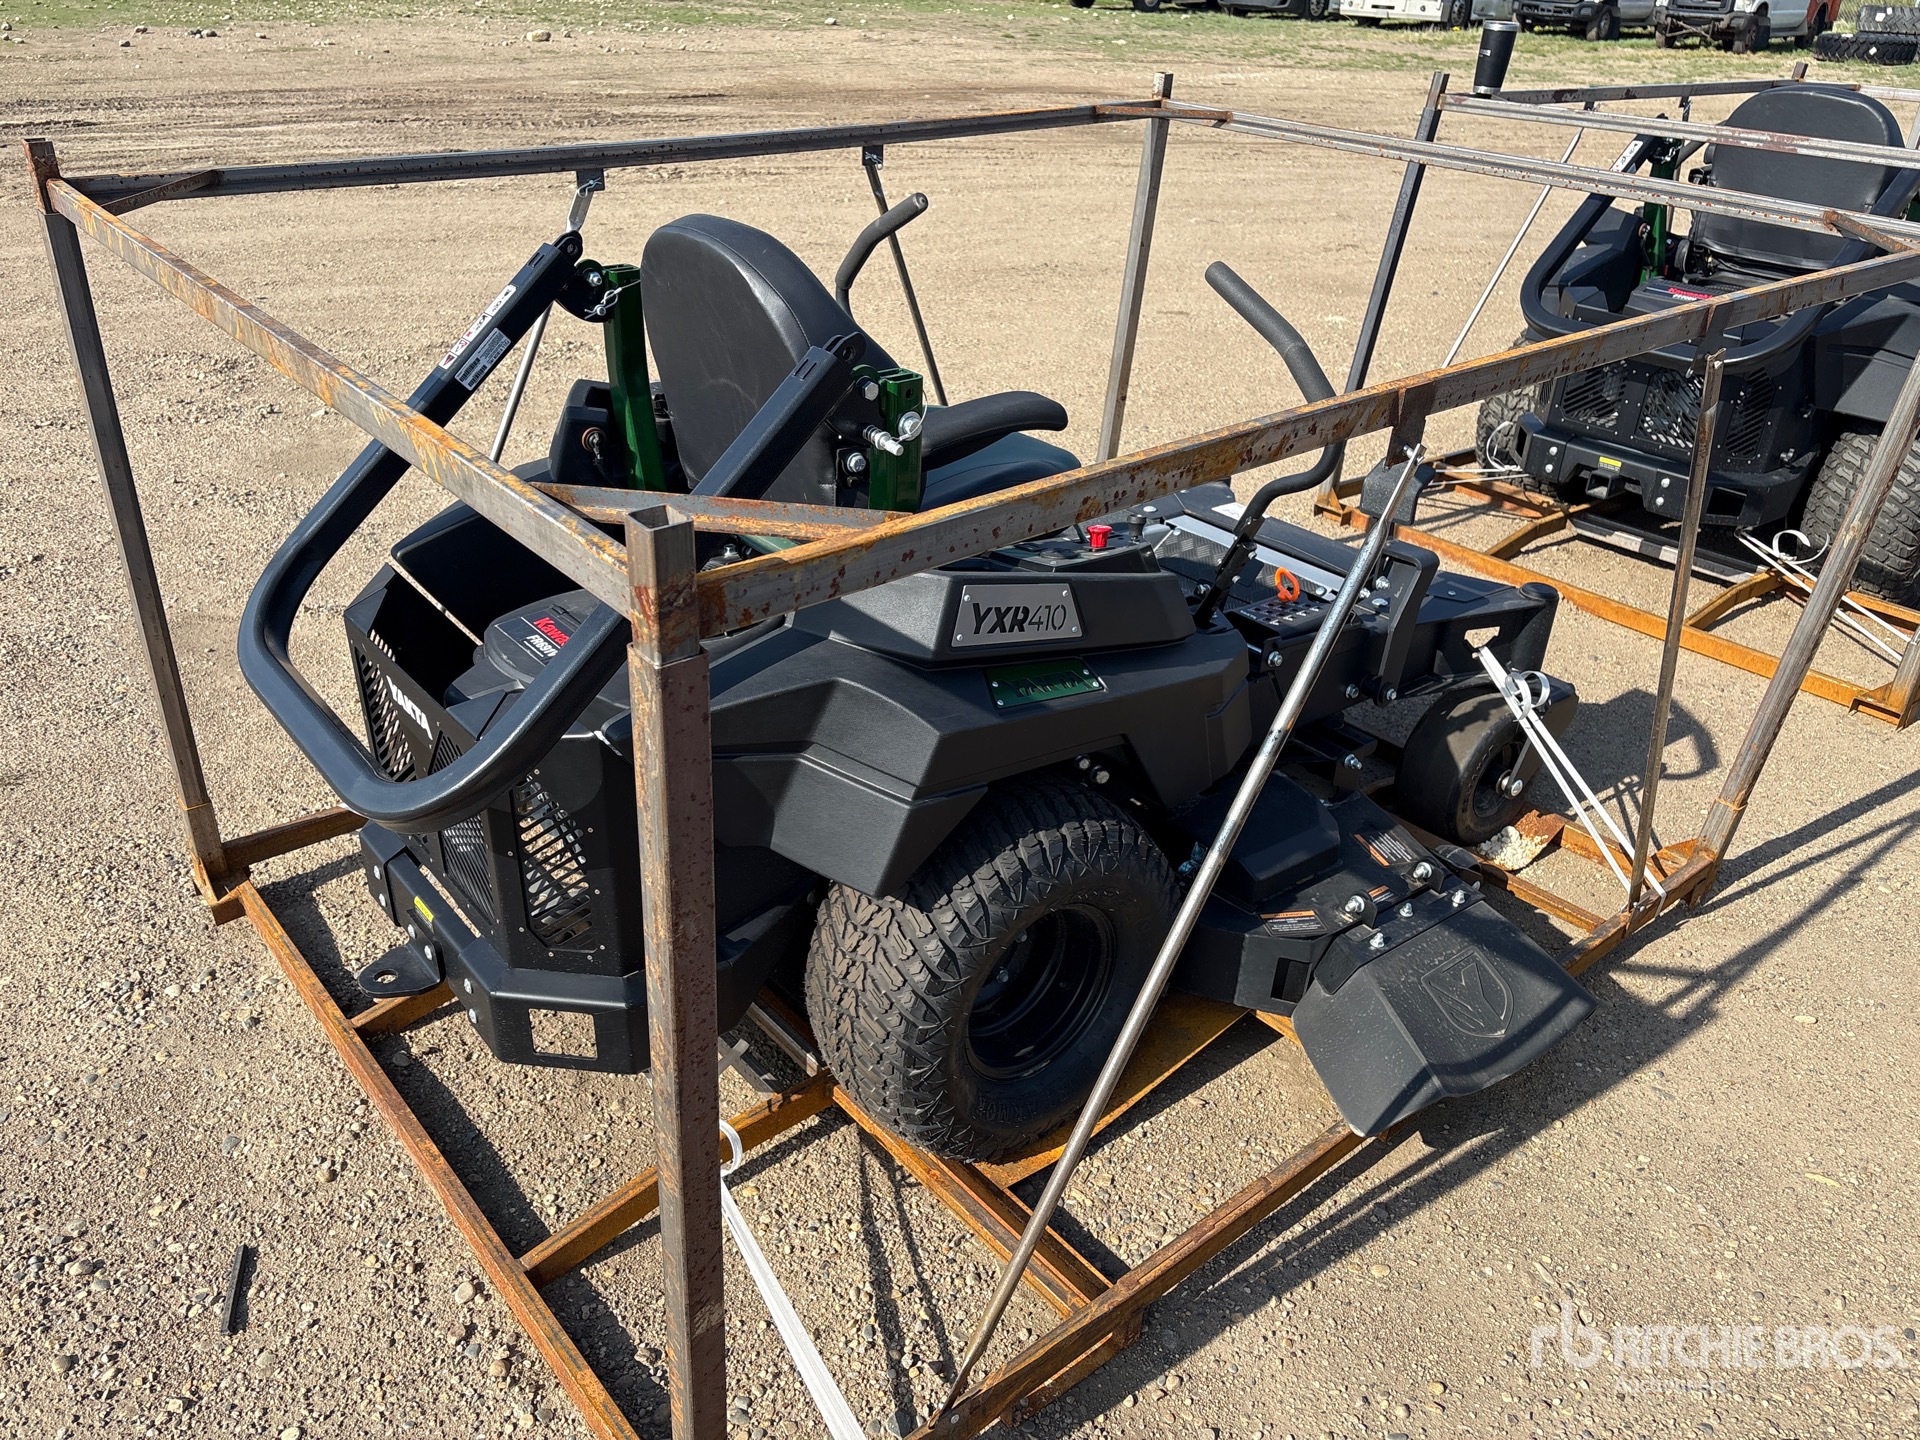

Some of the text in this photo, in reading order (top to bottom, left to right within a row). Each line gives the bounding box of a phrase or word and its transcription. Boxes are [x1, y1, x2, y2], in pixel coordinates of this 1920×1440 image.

[533, 617, 571, 647] Kawa
[972, 602, 1067, 635] YXR410
[386, 675, 433, 740] YAKTA
